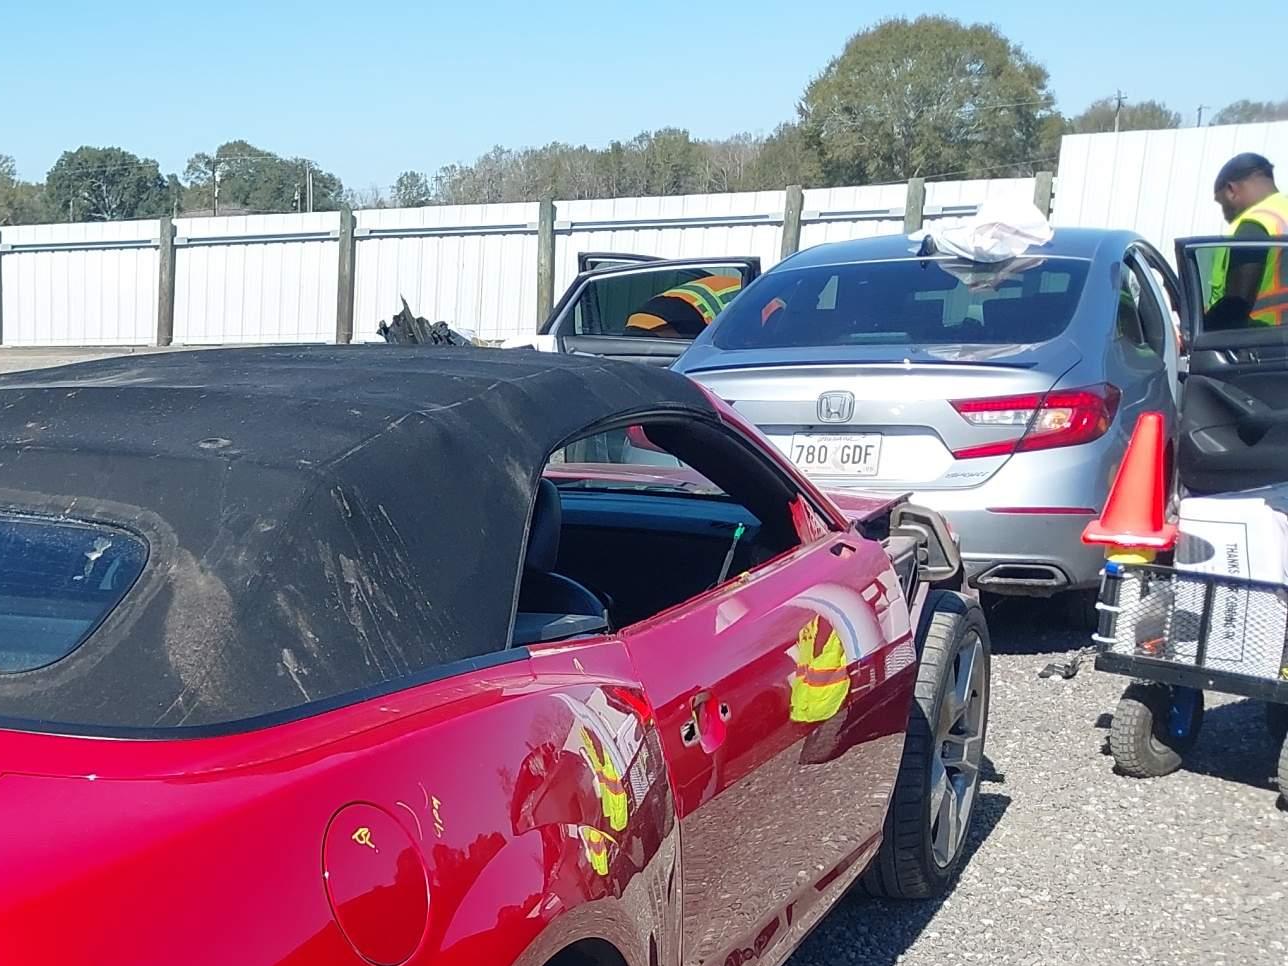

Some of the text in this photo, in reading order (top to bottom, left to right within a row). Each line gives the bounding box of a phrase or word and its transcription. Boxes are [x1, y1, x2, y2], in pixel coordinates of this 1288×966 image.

[795, 445, 875, 464] 780 GDF
[1226, 543, 1240, 575] THANKS
